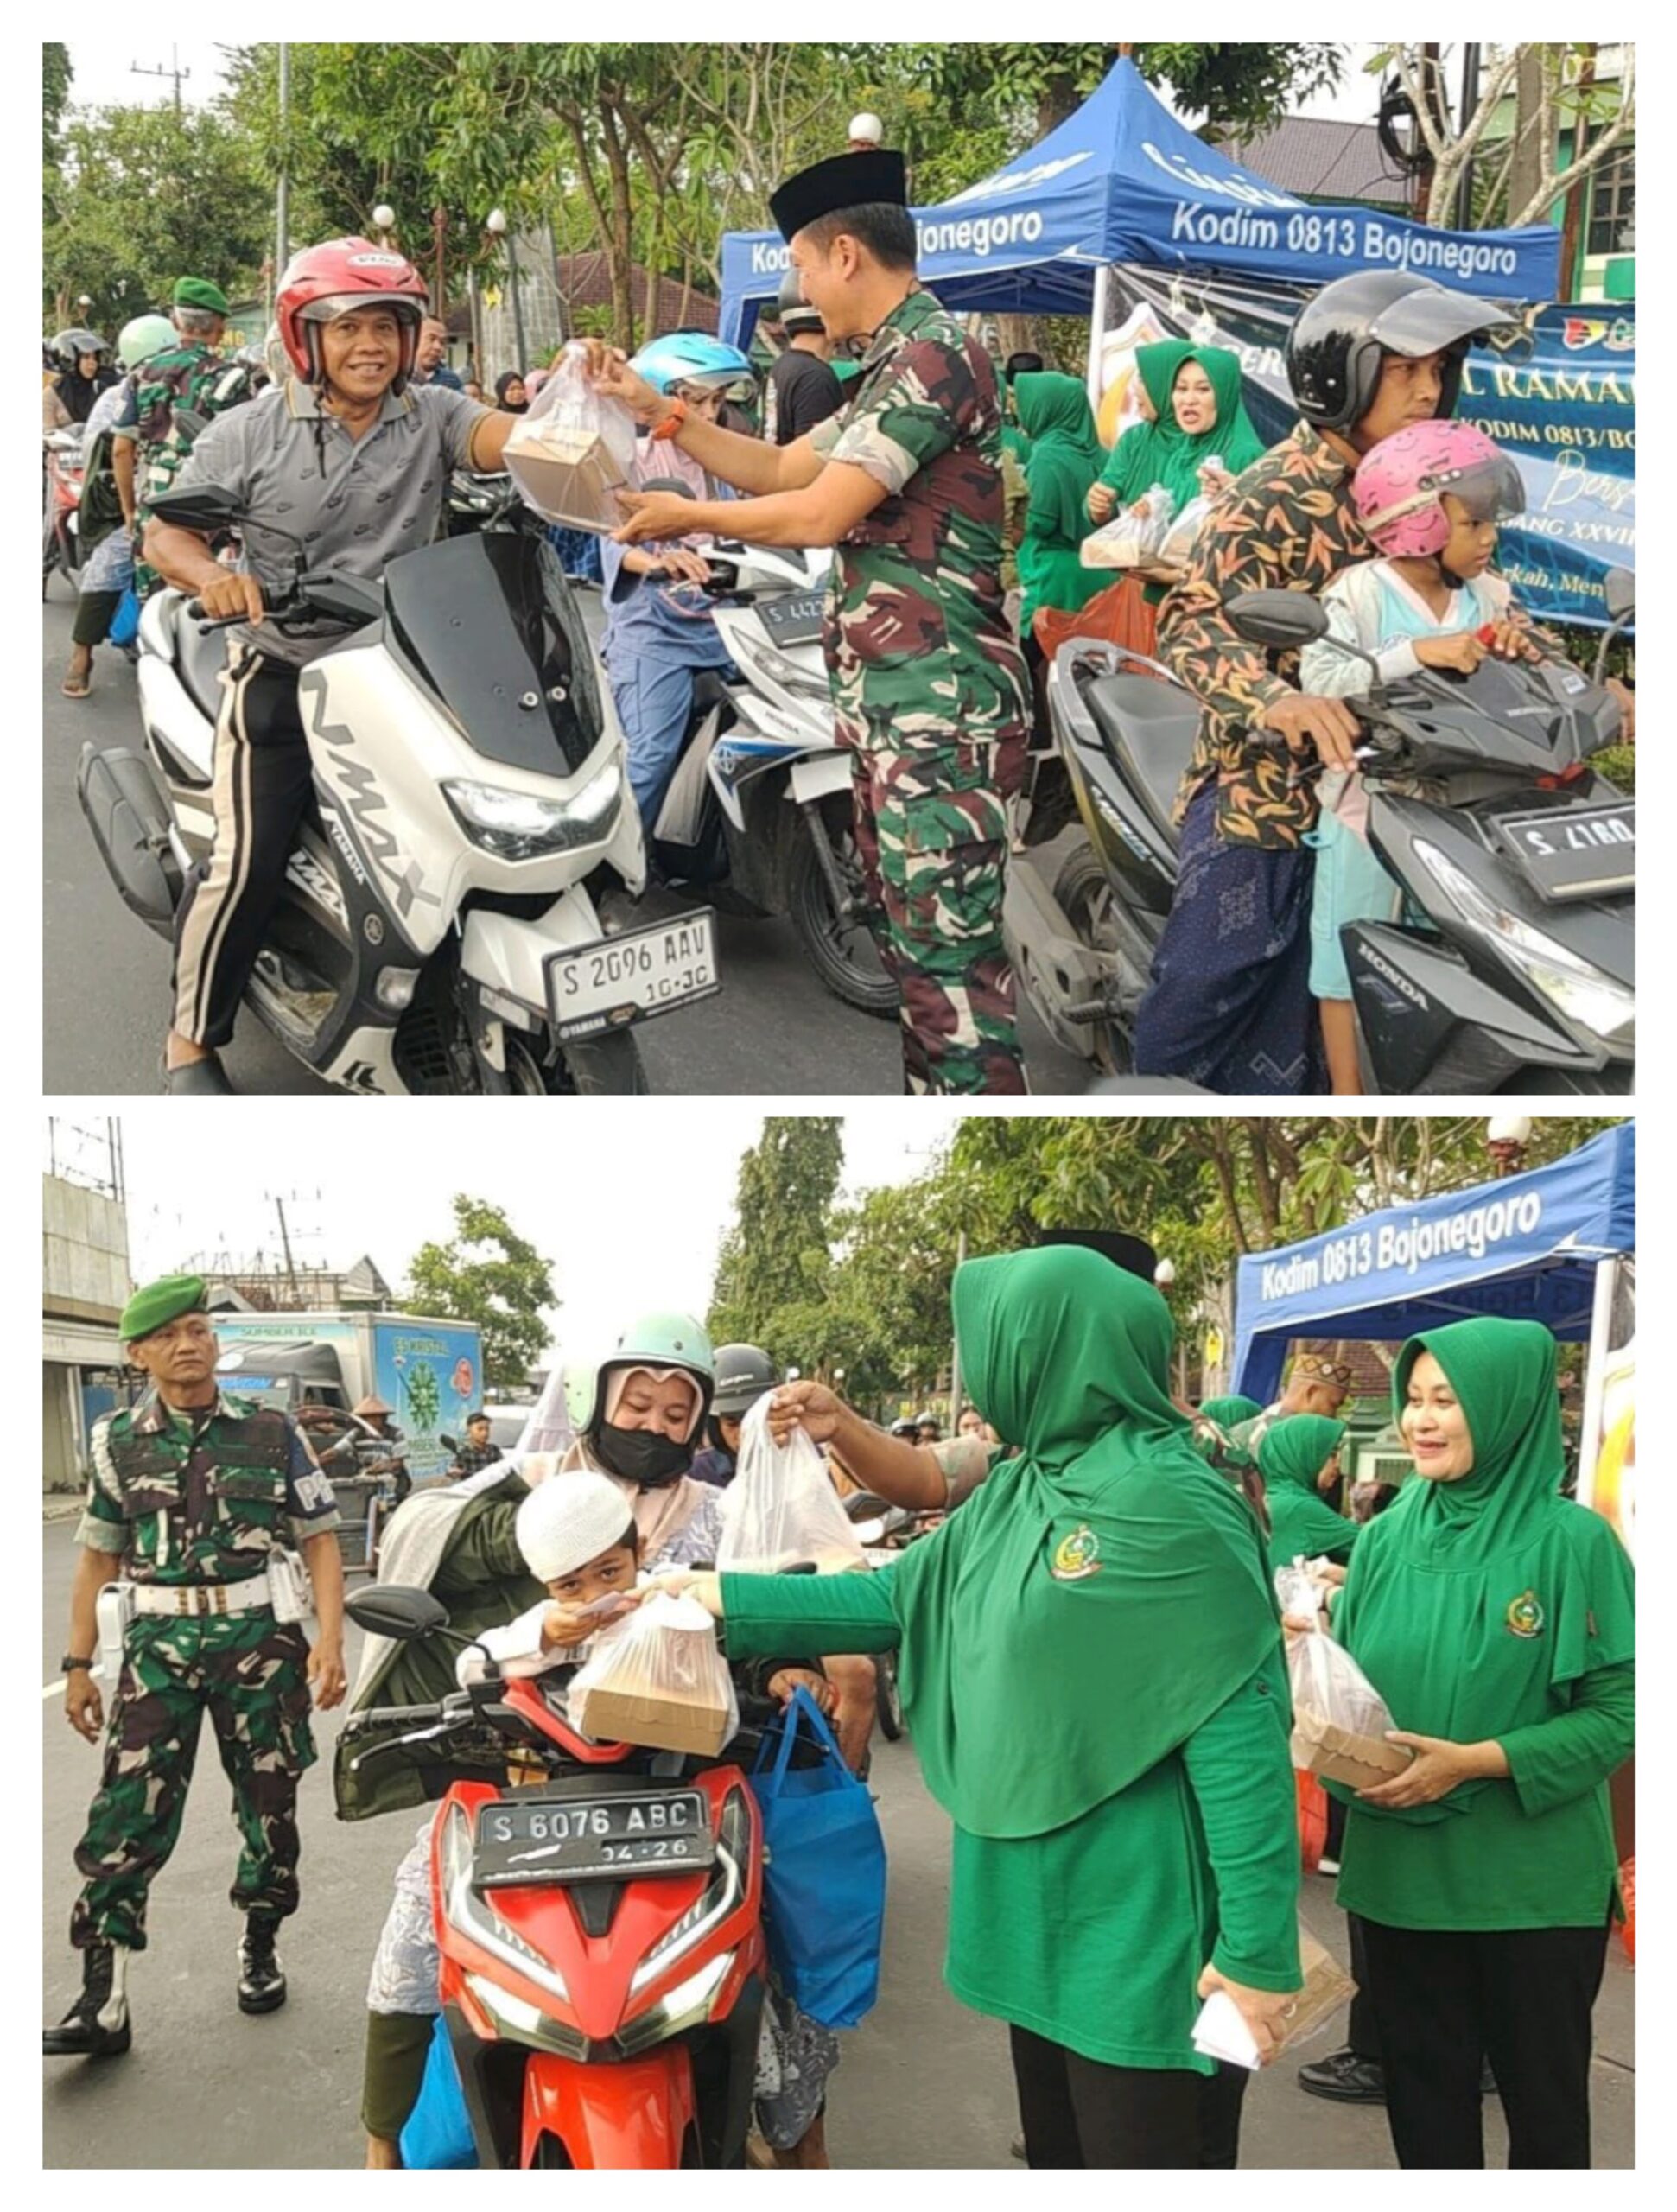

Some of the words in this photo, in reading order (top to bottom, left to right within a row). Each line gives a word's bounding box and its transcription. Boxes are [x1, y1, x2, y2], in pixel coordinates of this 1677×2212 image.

[752, 243, 792, 273] Kod
[916, 211, 1043, 262] jonegoro
[1172, 201, 1278, 249] Kodim
[1287, 213, 1356, 256] 0813
[1363, 222, 1517, 278] Bojonegoro
[1494, 365, 1635, 404] RAMA
[769, 607, 784, 622] S
[298, 669, 442, 919] NMAX
[563, 963, 579, 995] S
[591, 944, 652, 988] 2096
[664, 925, 706, 966] AAV
[1357, 941, 1429, 1011] HONDA
[1261, 1253, 1319, 1300] Kodim
[1323, 1235, 1372, 1285] 0813
[1377, 1192, 1541, 1274] Bojonegoro
[493, 1816, 513, 1842] S
[530, 1808, 611, 1840] 6076
[626, 1802, 688, 1832] ABC
